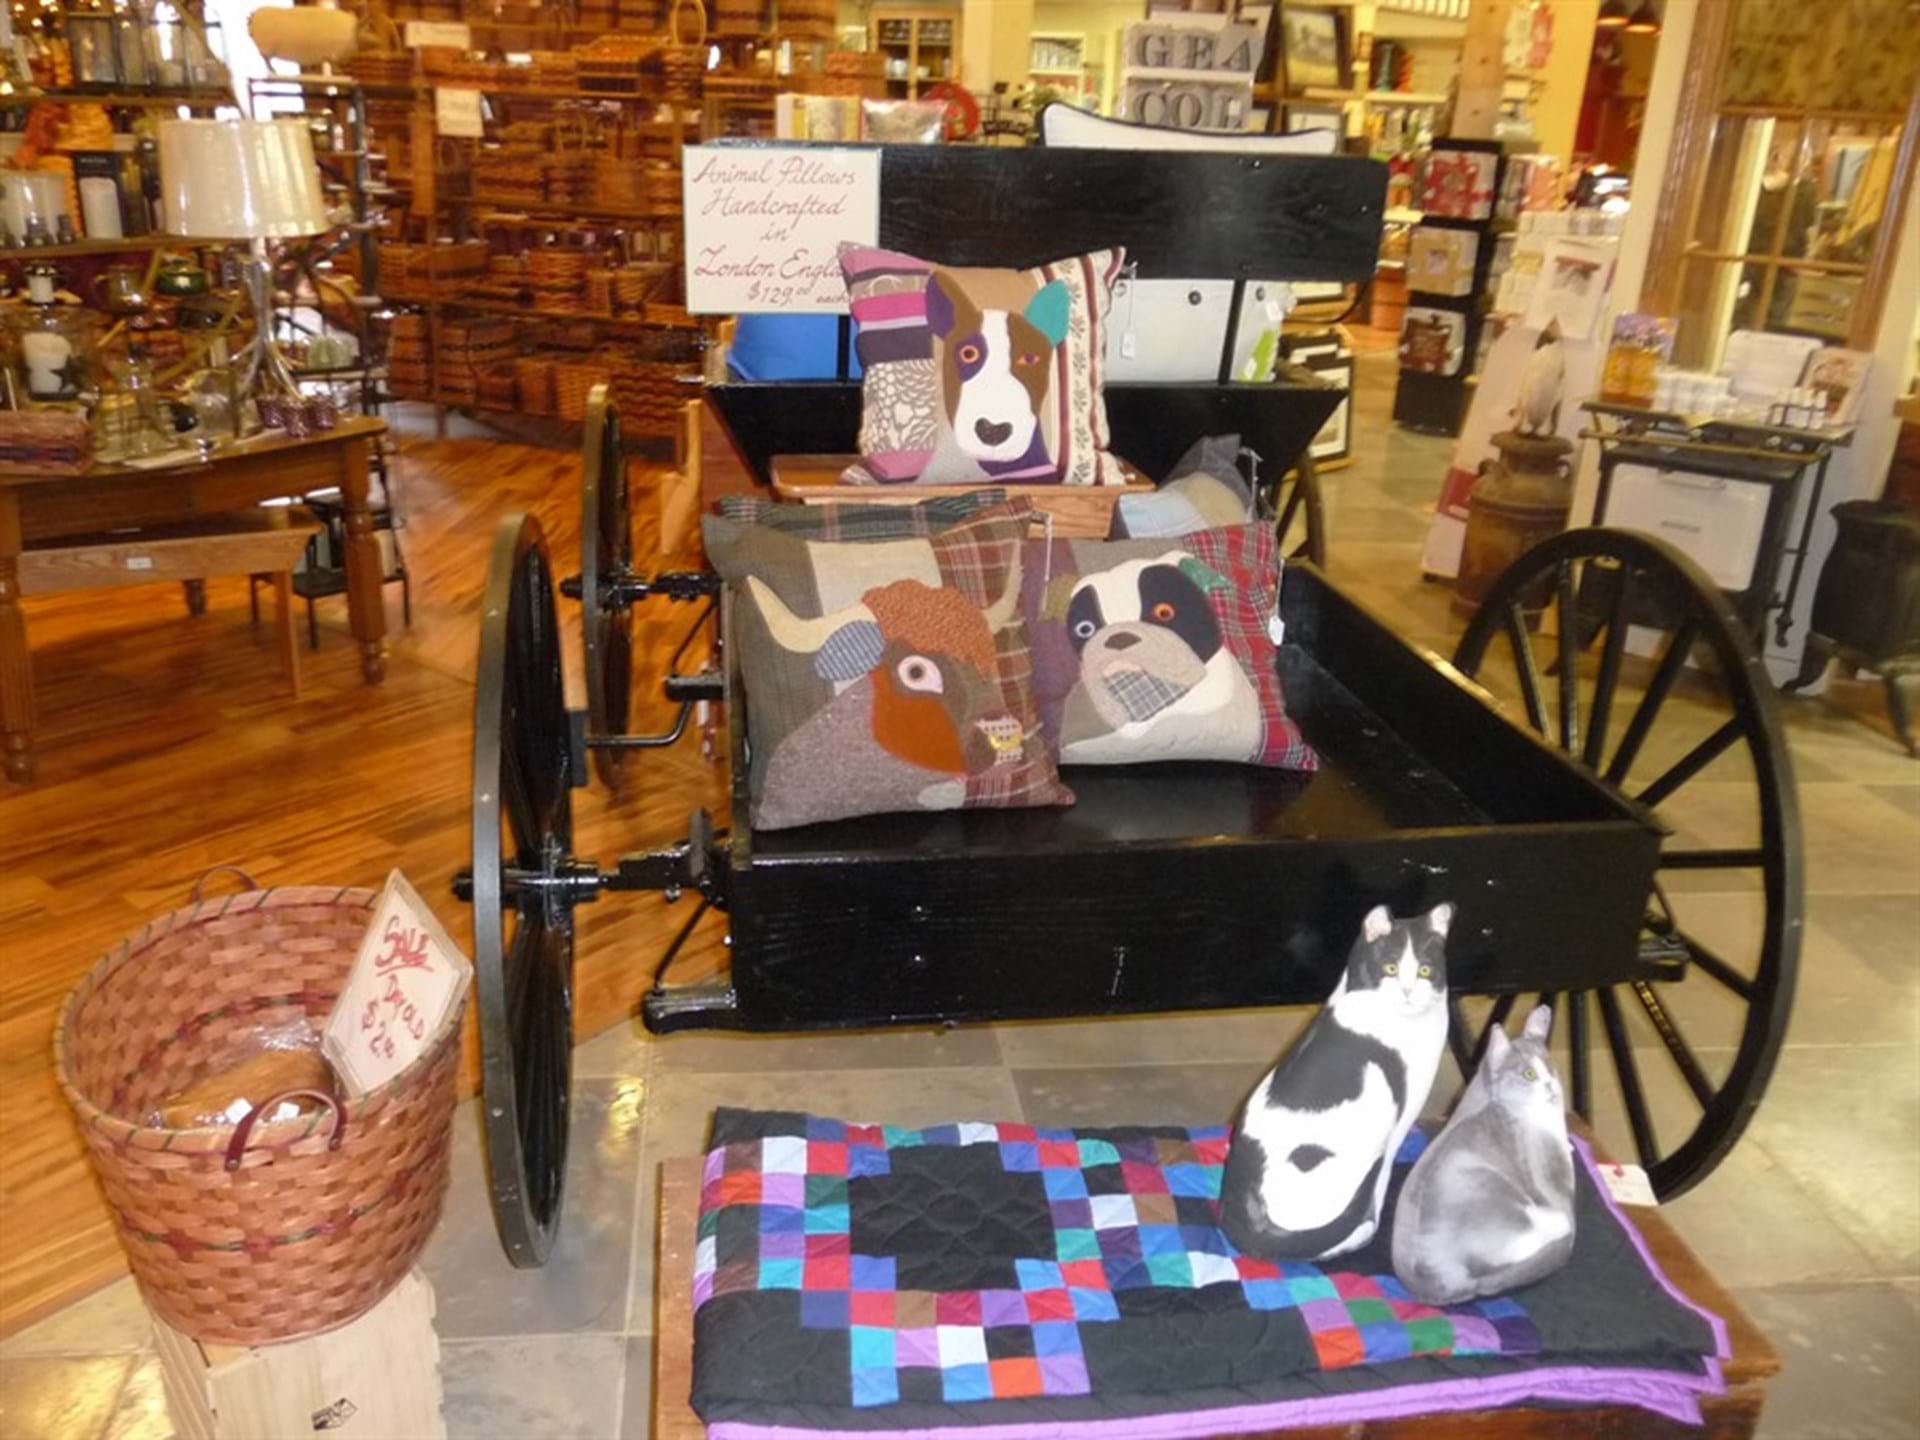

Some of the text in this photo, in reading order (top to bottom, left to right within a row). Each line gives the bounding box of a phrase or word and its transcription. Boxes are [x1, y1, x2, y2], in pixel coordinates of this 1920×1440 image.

[692, 156, 856, 187] Animal Pillows
[701, 187, 849, 230] Handcrafted
[760, 223, 791, 241] in
[694, 244, 843, 289] London Engla
